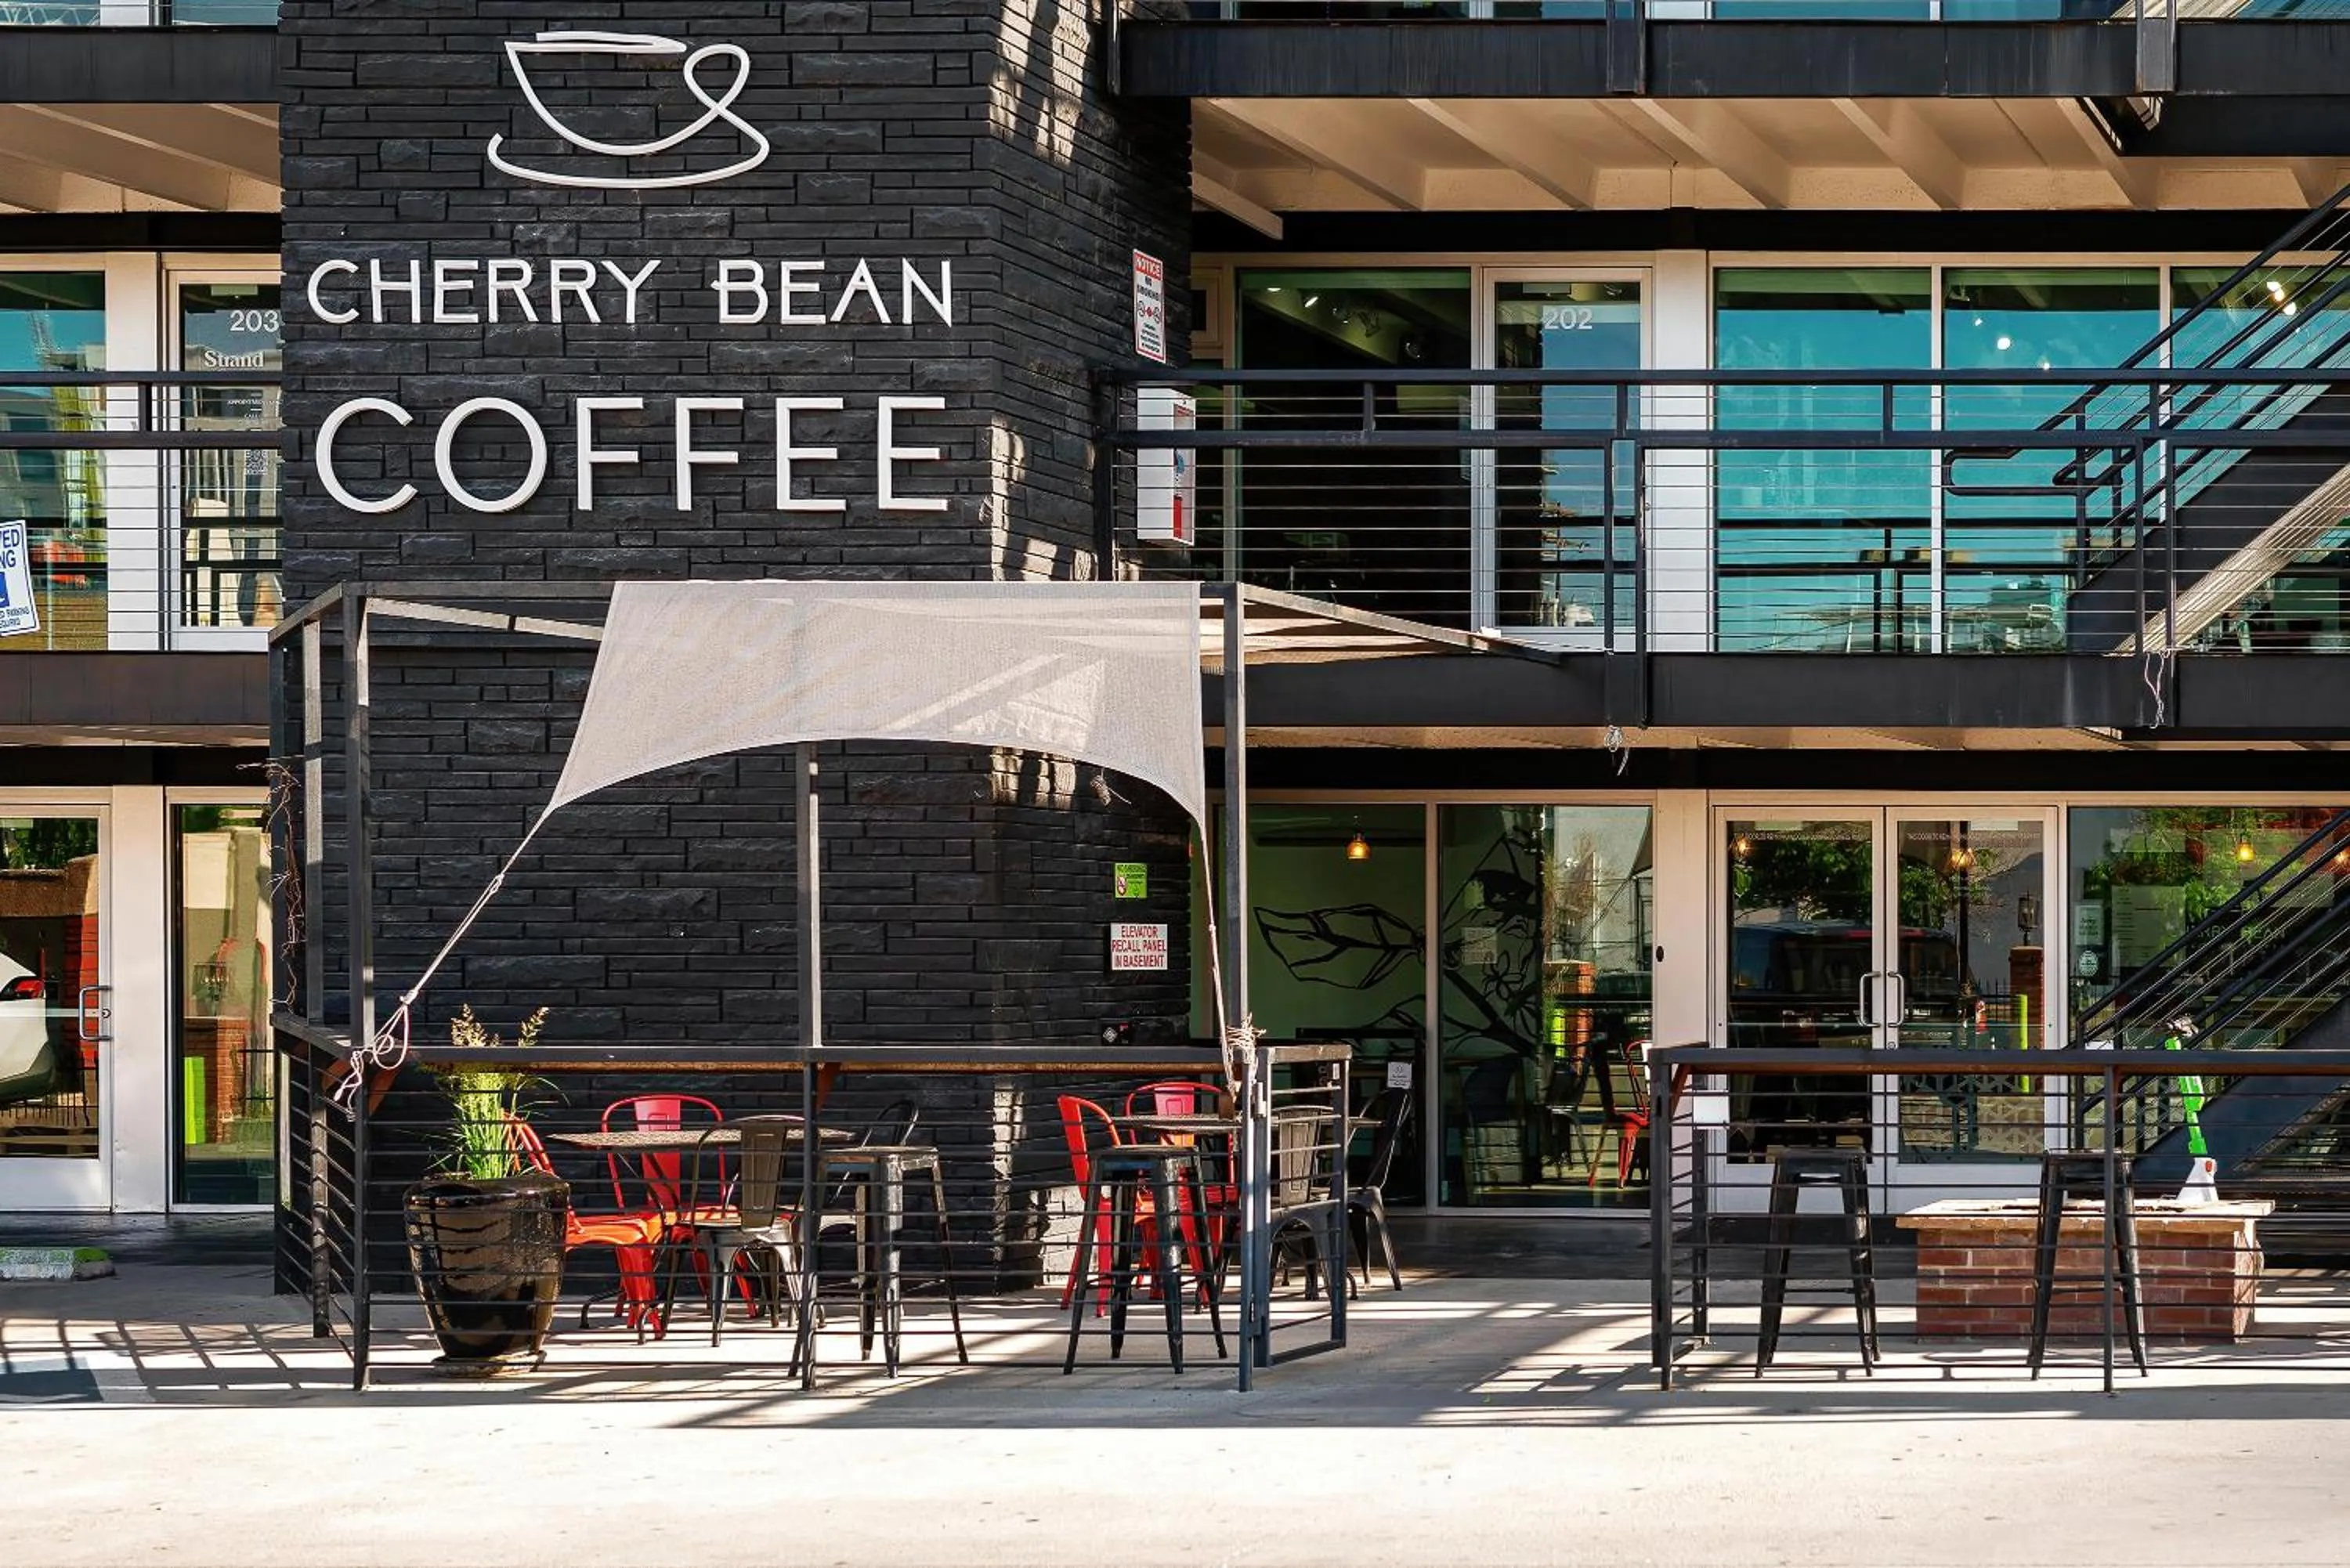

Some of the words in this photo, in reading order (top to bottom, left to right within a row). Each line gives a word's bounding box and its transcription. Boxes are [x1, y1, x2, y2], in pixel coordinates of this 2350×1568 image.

[307, 258, 661, 323] CHERRY
[710, 257, 952, 327] BEAN
[230, 310, 280, 333] 203
[1544, 308, 1593, 330] 202
[204, 350, 265, 368] Strand
[316, 396, 949, 514] COFFEE
[1121, 926, 1159, 938] ELEVATOR
[1112, 940, 1141, 952] RECALL
[1143, 940, 1166, 952] PANEL
[1115, 956, 1122, 967] IN
[1123, 955, 1165, 967] BASEMENT
